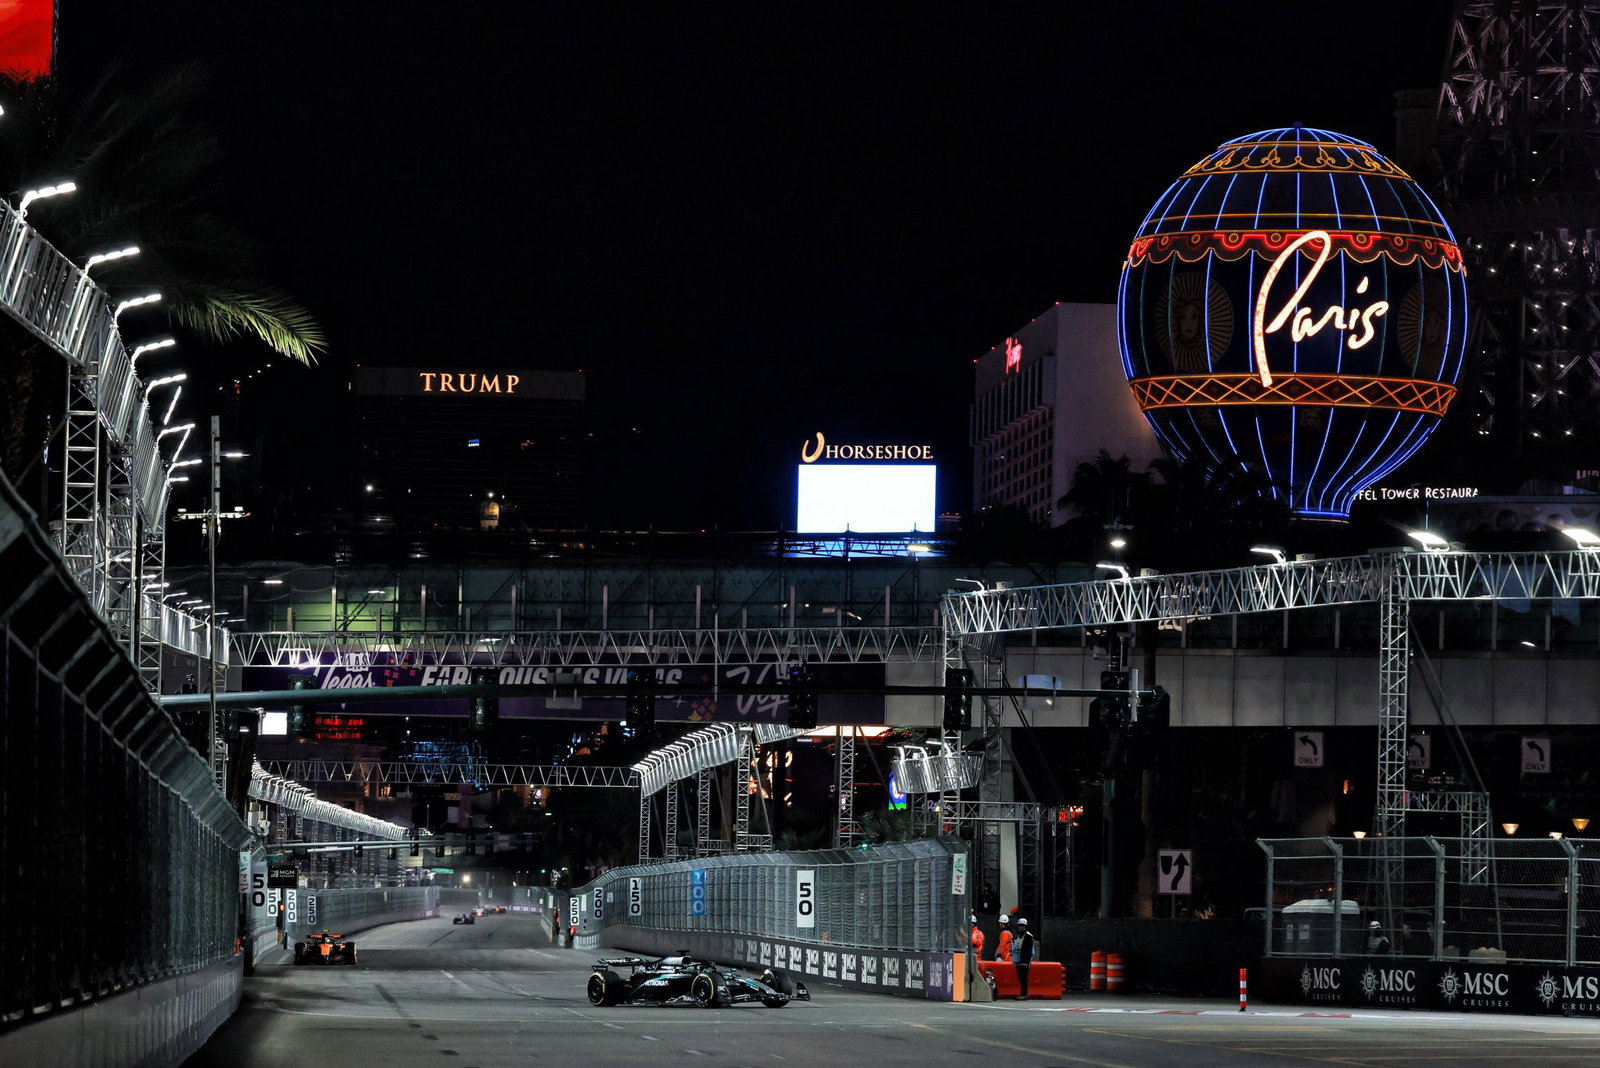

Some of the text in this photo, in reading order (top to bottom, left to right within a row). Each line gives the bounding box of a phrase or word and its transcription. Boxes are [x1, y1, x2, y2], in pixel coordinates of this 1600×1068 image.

[1254, 230, 1389, 388] Paris
[420, 372, 520, 394] TRUMP
[825, 445, 931, 460] HORSESHOE
[1381, 488, 1419, 500] TOWER
[421, 666, 549, 687] FABOUS
[1298, 756, 1319, 765] ONLY
[1525, 762, 1546, 771] ONLY
[252, 874, 265, 906] 50
[631, 880, 640, 914] 150
[693, 871, 704, 913] 100
[799, 882, 812, 915] 50
[288, 891, 296, 921] 200
[571, 899, 579, 924] 250
[594, 888, 603, 919] 200
[911, 959, 924, 977] MGM
[1313, 967, 1341, 989] MSC
[1380, 969, 1416, 992] MSC
[1463, 972, 1509, 996] MSC
[1562, 975, 1599, 999] MS
[1313, 993, 1341, 1001] CRUISES
[1380, 995, 1416, 1003] CRUISES
[1463, 998, 1509, 1007] CRUISES
